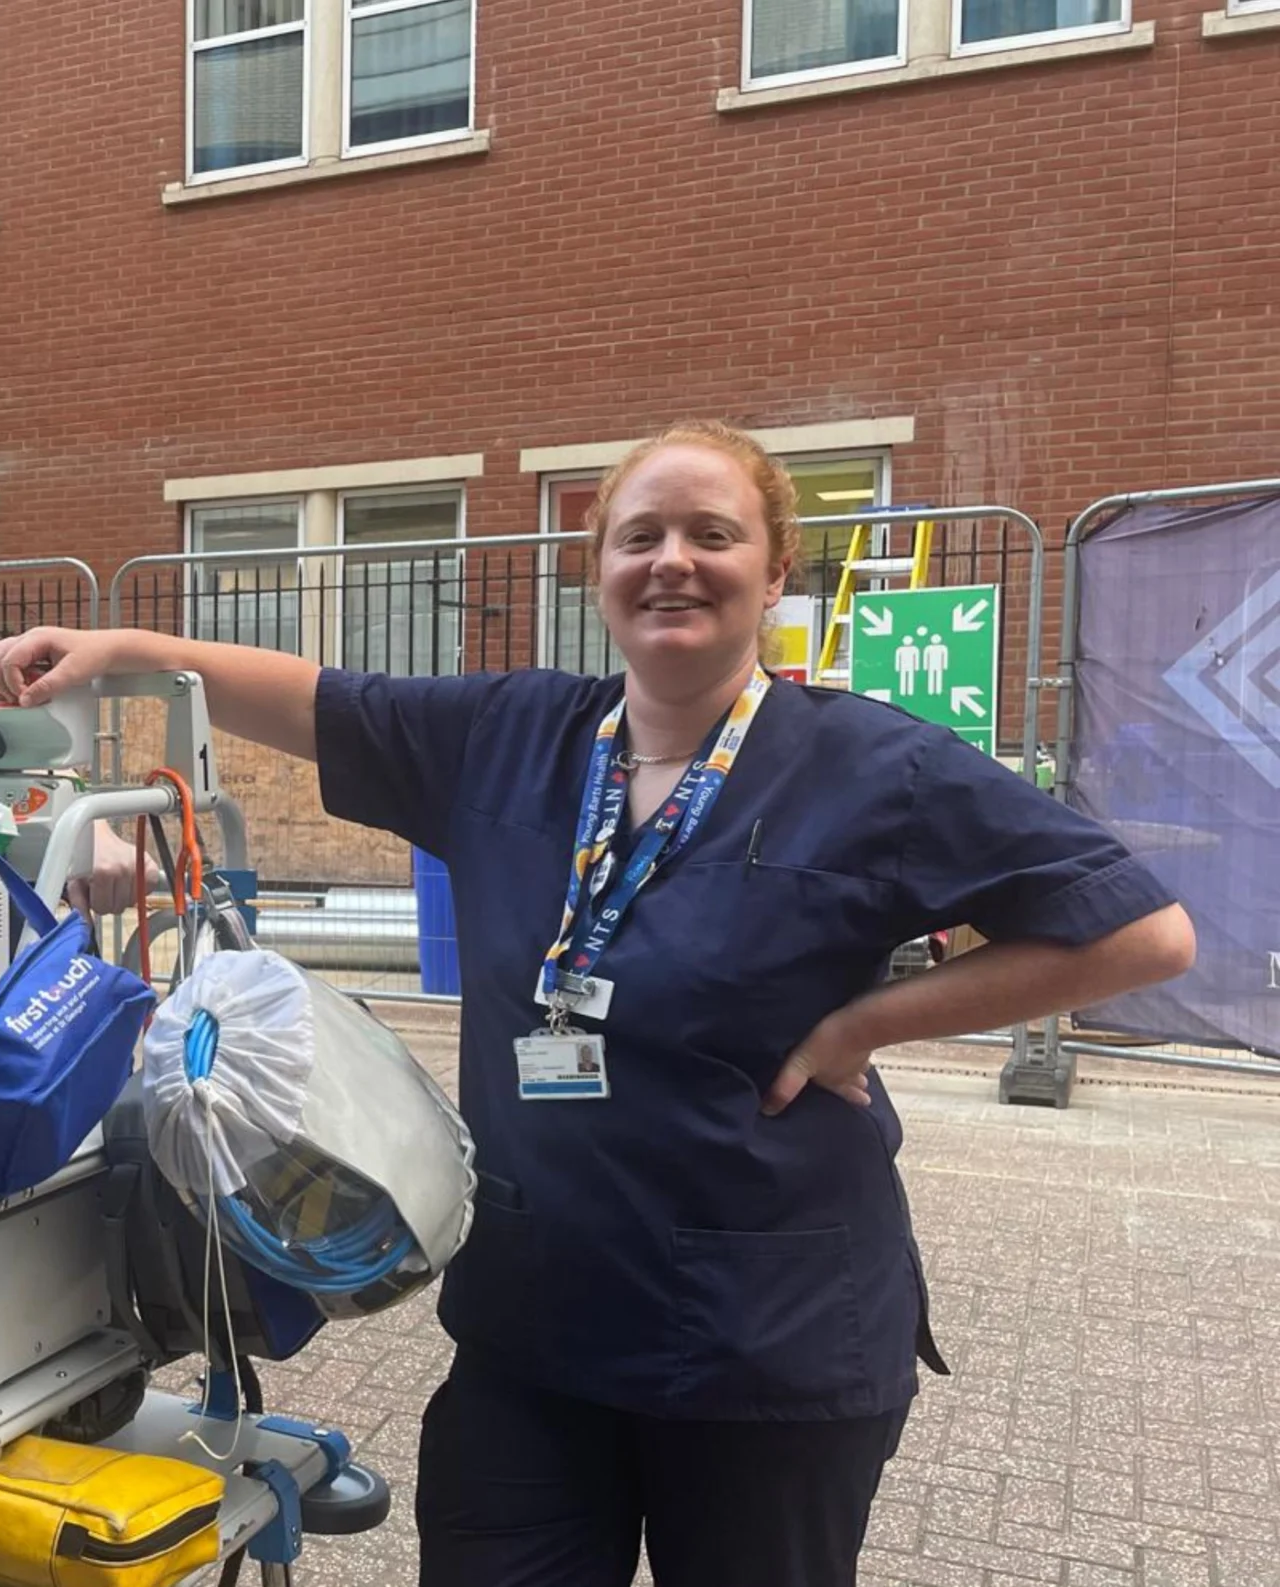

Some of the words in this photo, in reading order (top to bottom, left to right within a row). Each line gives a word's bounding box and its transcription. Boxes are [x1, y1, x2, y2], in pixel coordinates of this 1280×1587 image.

[199, 742, 209, 792] 1
[593, 753, 609, 786] Health
[674, 760, 707, 801] NTS
[588, 786, 602, 812] Barts
[601, 788, 623, 830] NTS
[690, 786, 715, 816] Young
[581, 811, 599, 843] Young
[584, 908, 620, 951] NTS
[4, 997, 49, 1034] first
[38, 957, 94, 1002] touch
